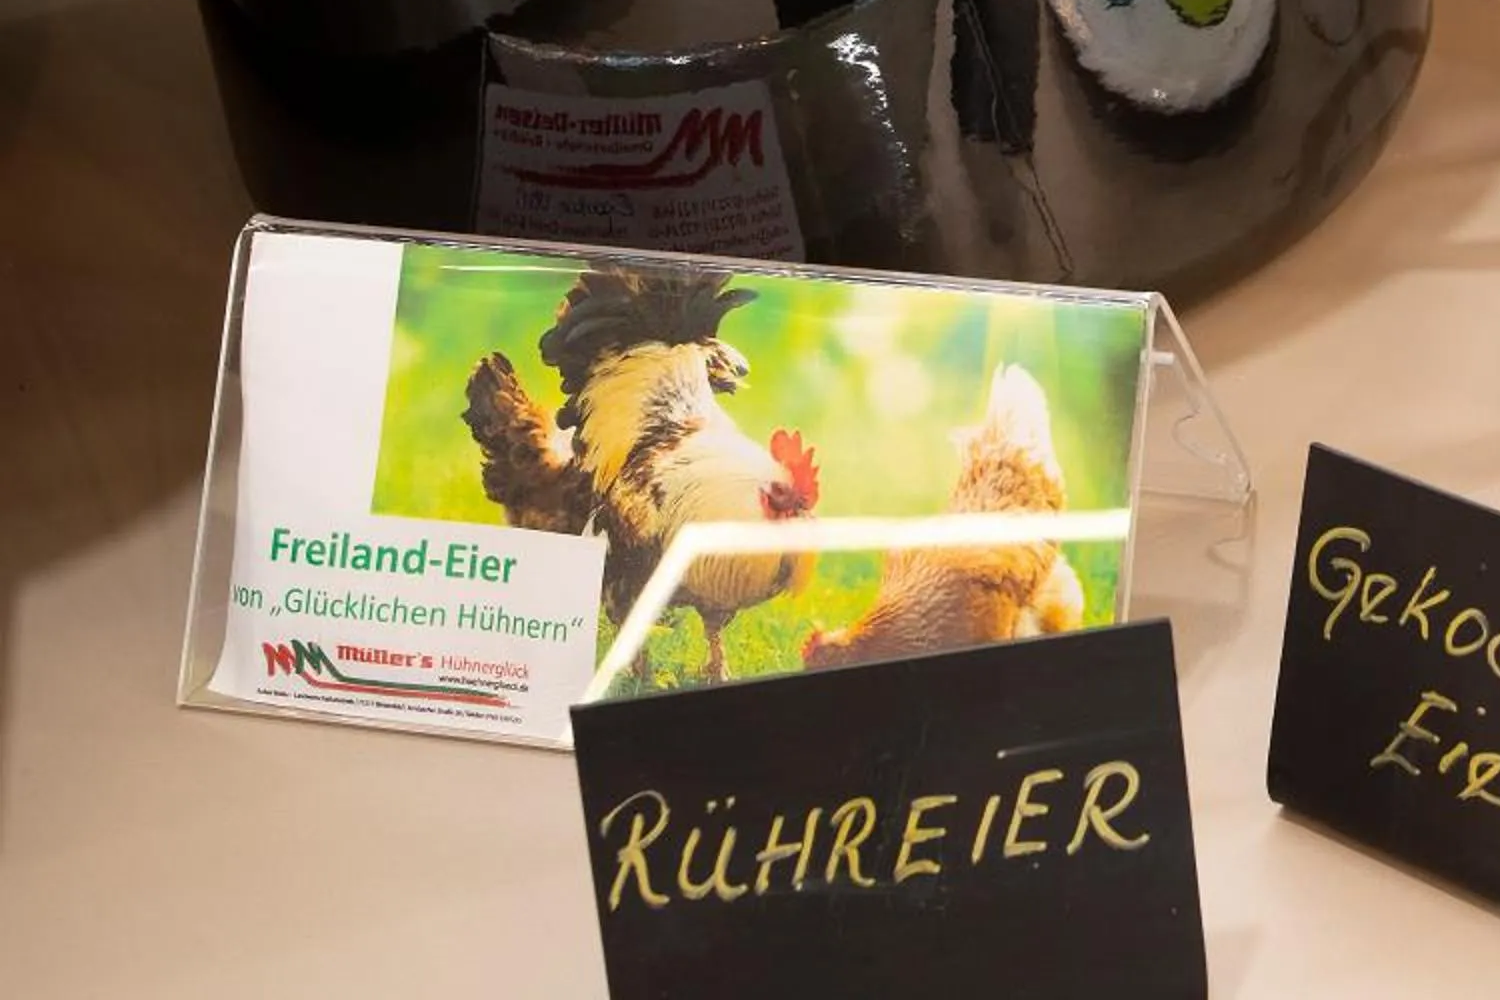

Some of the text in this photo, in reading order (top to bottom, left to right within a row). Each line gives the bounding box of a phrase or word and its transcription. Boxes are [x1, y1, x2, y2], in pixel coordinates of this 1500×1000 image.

[269, 527, 518, 584] Freiland-Eier
[232, 584, 264, 609] von
[600, 759, 1150, 911] RÜHREIER
